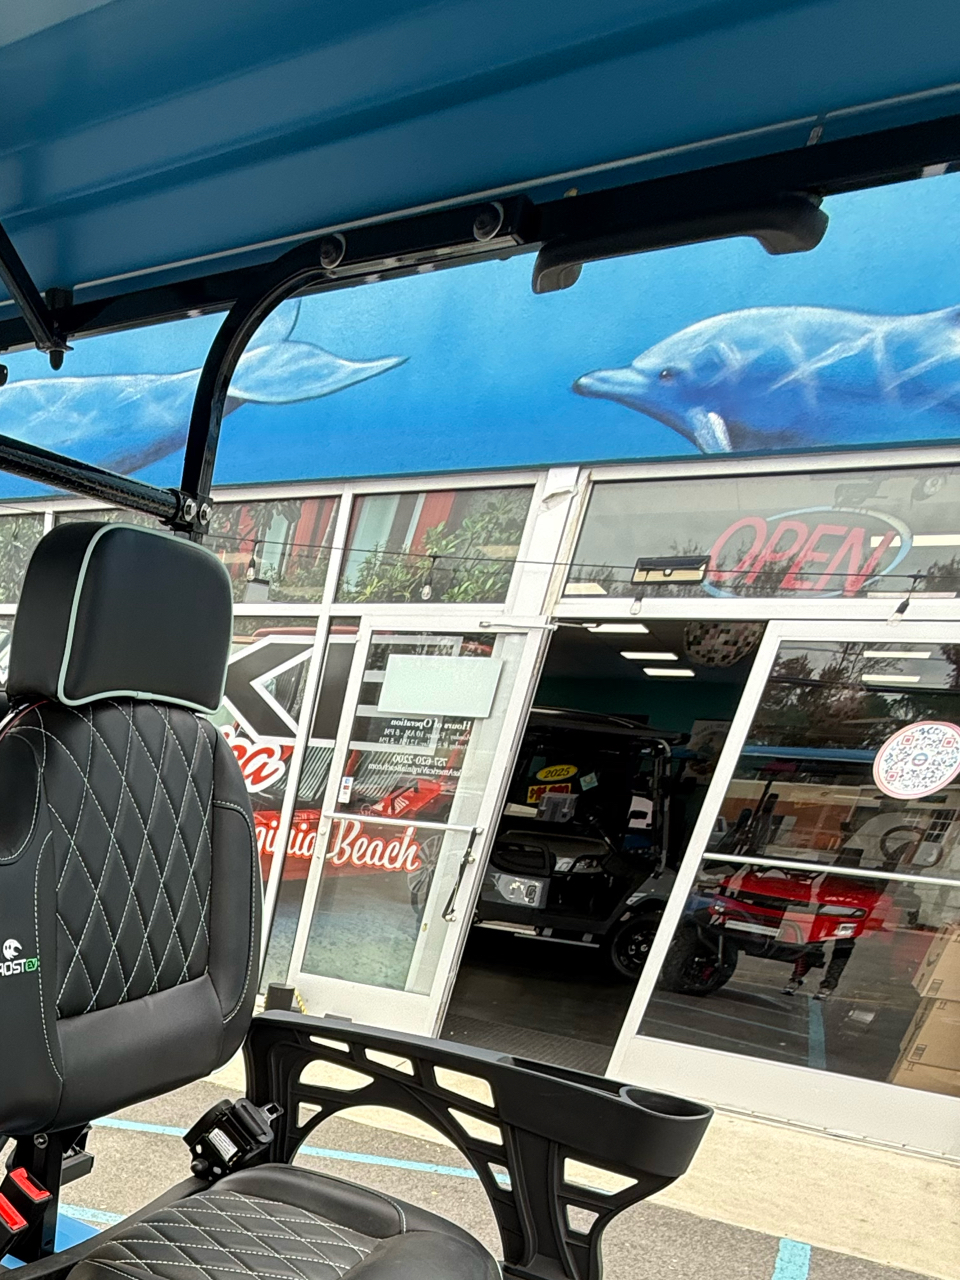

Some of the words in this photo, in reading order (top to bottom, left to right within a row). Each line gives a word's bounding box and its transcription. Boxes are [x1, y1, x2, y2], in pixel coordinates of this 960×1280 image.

[707, 516, 897, 597] OPEN
[543, 767, 571, 779] 2025
[324, 818, 421, 873] Beach
